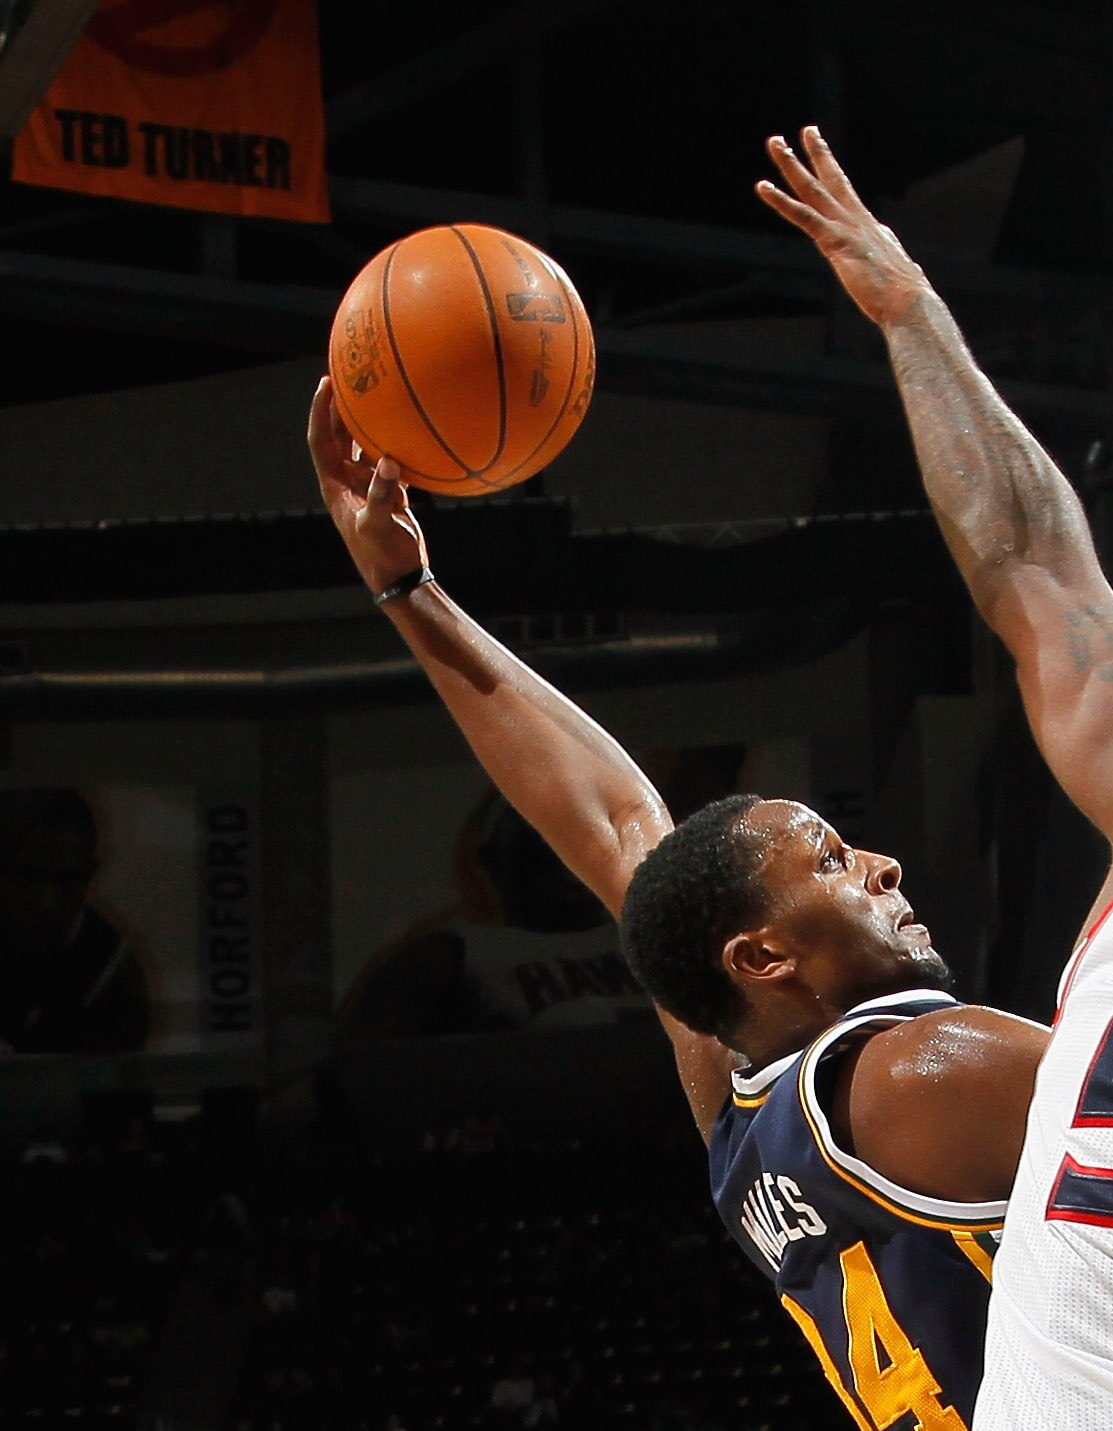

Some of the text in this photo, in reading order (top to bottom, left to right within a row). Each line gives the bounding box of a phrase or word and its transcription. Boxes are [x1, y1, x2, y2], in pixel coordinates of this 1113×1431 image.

[54, 109, 292, 191] TED TURNER
[207, 805, 252, 1032] HORFORD
